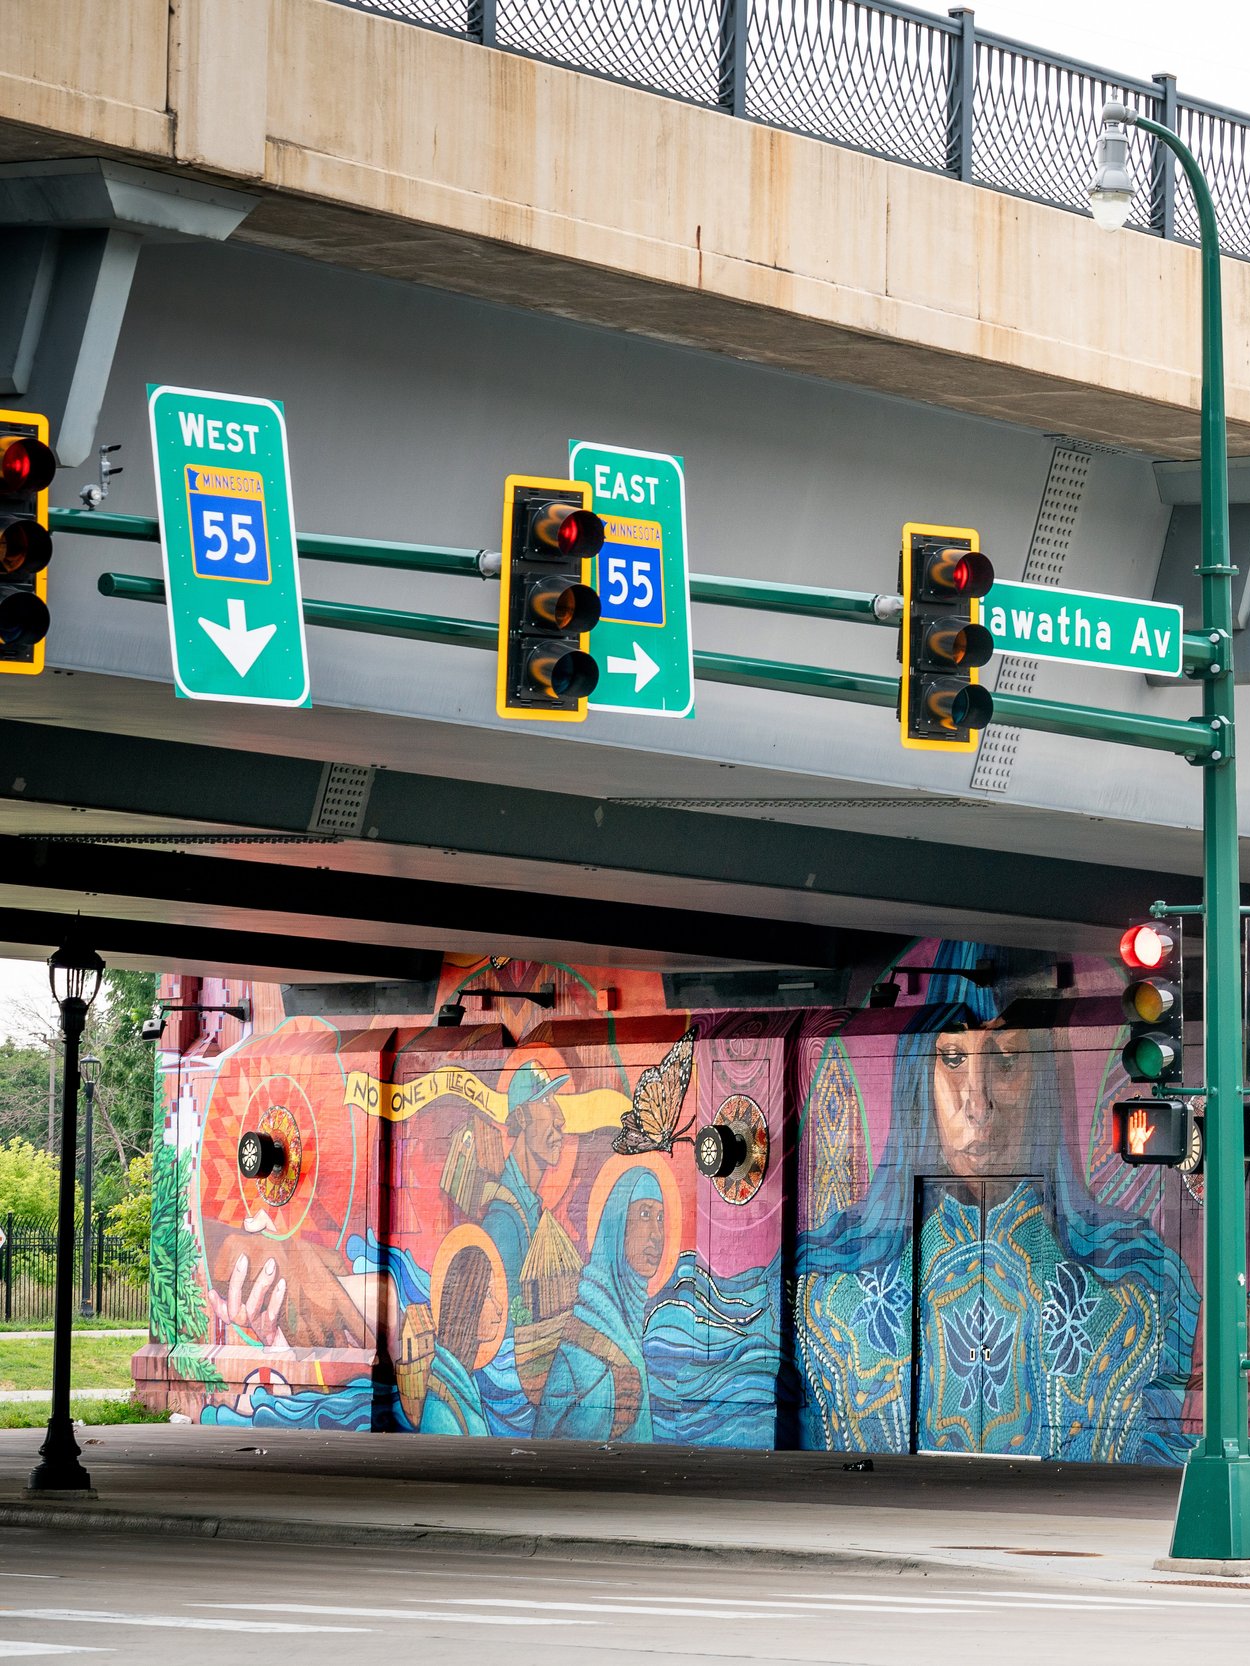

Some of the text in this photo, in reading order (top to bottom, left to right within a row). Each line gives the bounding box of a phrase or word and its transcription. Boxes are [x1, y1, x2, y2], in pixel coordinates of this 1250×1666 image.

[178, 411, 260, 455] WEST
[202, 473, 262, 493] MINNESOTA
[594, 464, 659, 505] EAST
[202, 510, 257, 564] 55
[609, 523, 661, 541] MINNESOTA
[607, 557, 654, 608] 55
[1129, 617, 1171, 659] Av
[353, 1071, 497, 1117] NO ONE IS ILLEGAL
